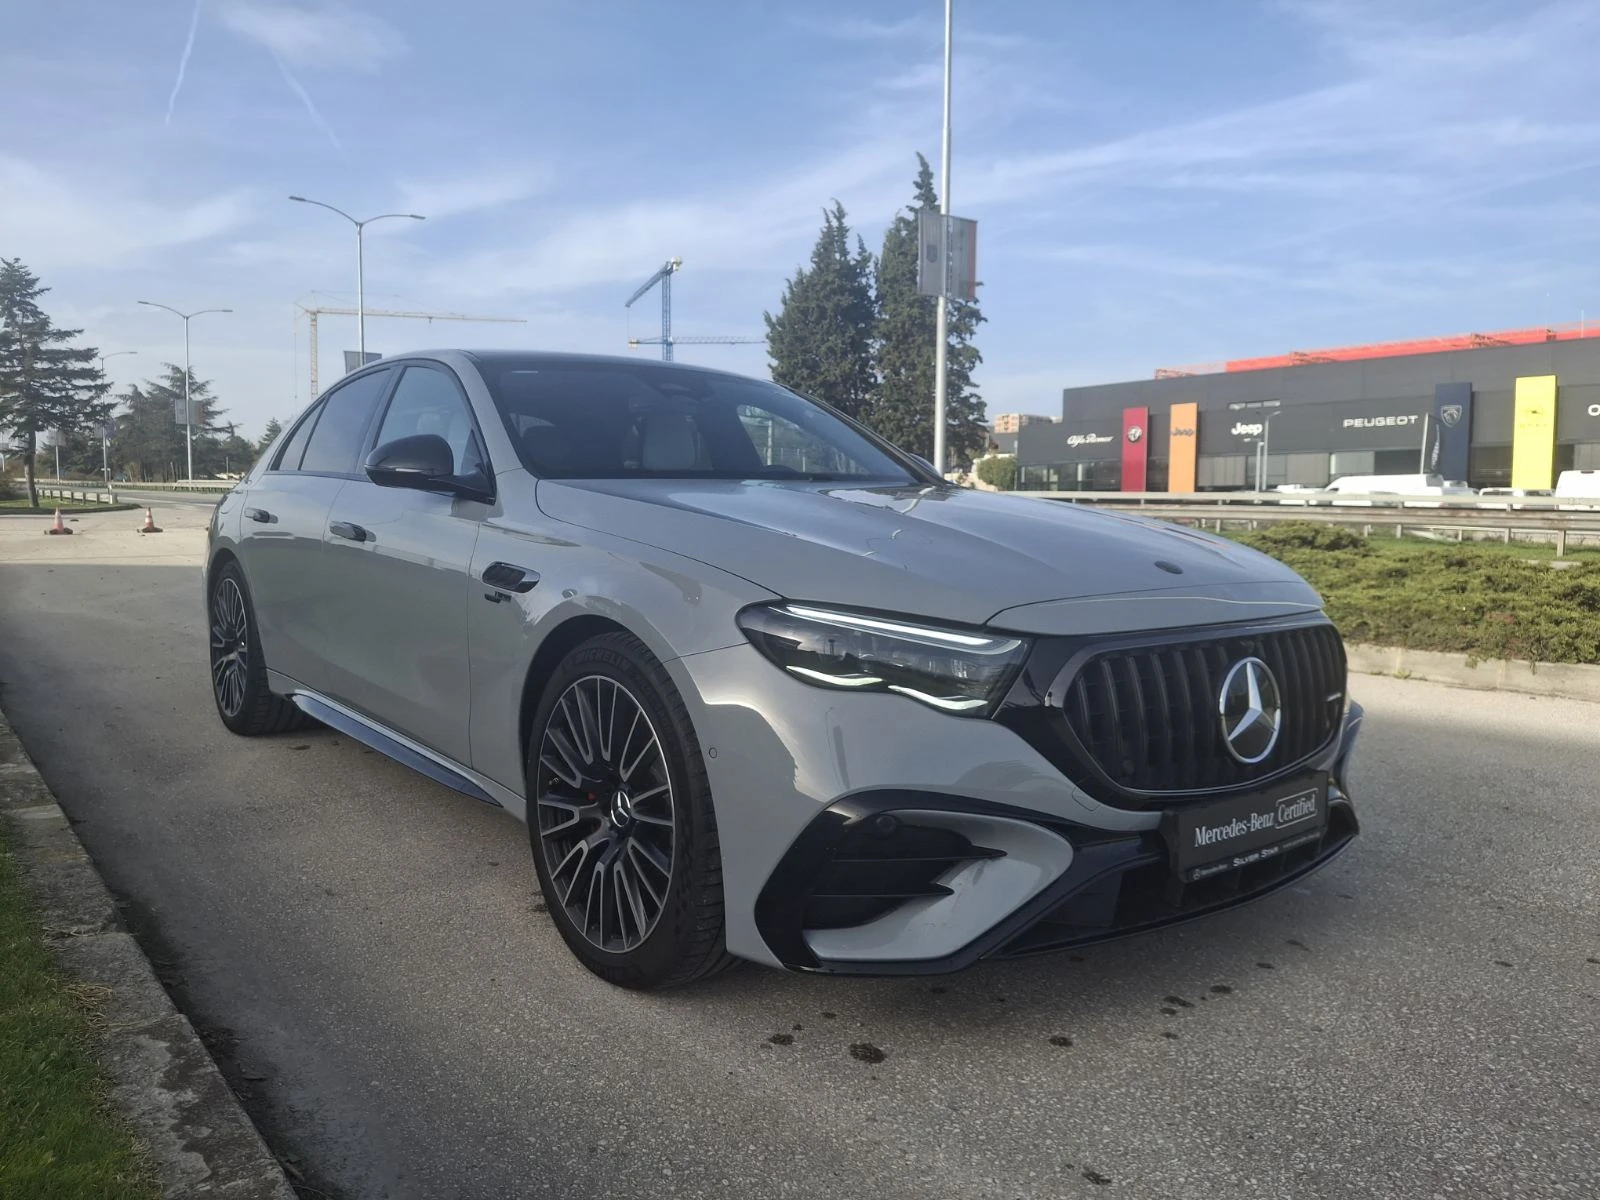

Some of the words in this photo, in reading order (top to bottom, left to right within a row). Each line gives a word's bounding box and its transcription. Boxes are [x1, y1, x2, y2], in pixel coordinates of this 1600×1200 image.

[1231, 422, 1262, 436] Jeep
[1343, 415, 1418, 428] PEUGEOT
[574, 648, 631, 672] MICHELIN
[1194, 812, 1274, 847] Mercedes-Benz
[1278, 794, 1315, 823] Certified
